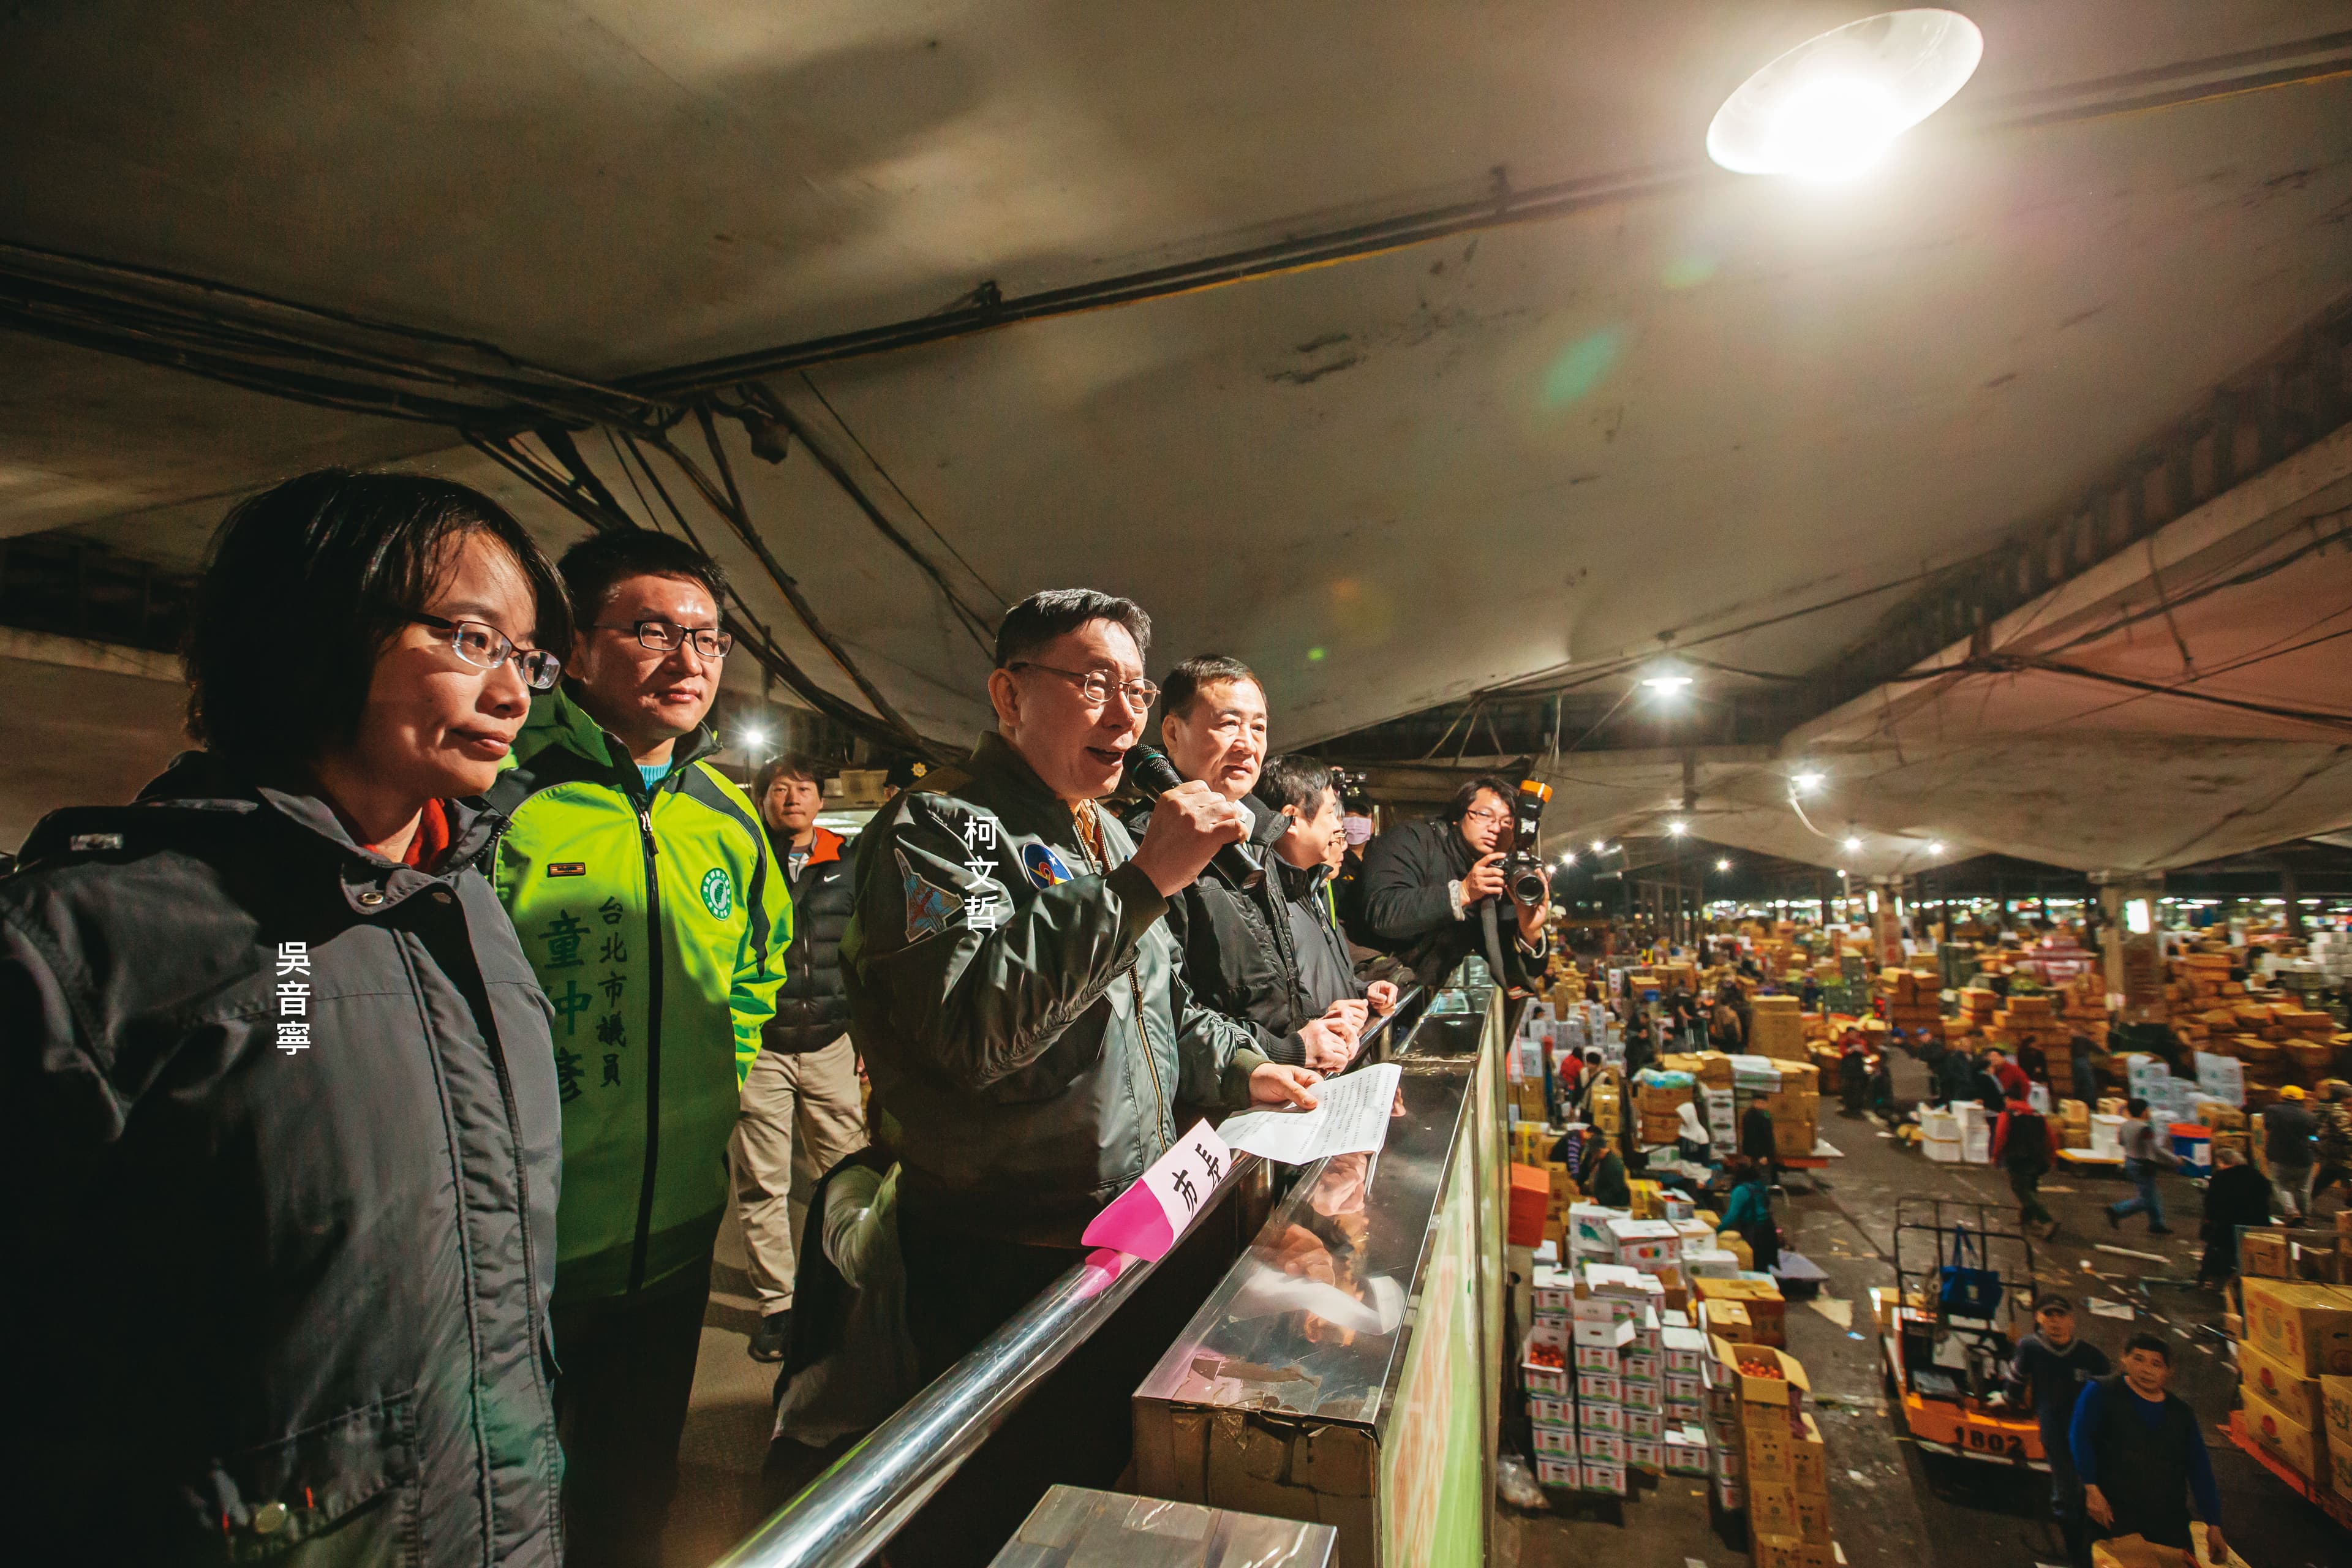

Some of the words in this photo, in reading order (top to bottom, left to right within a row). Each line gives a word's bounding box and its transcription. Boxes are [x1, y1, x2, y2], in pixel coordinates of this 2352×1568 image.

[596, 895, 628, 1088] 台北市議員
[1955, 1426, 2026, 1456] 1802
